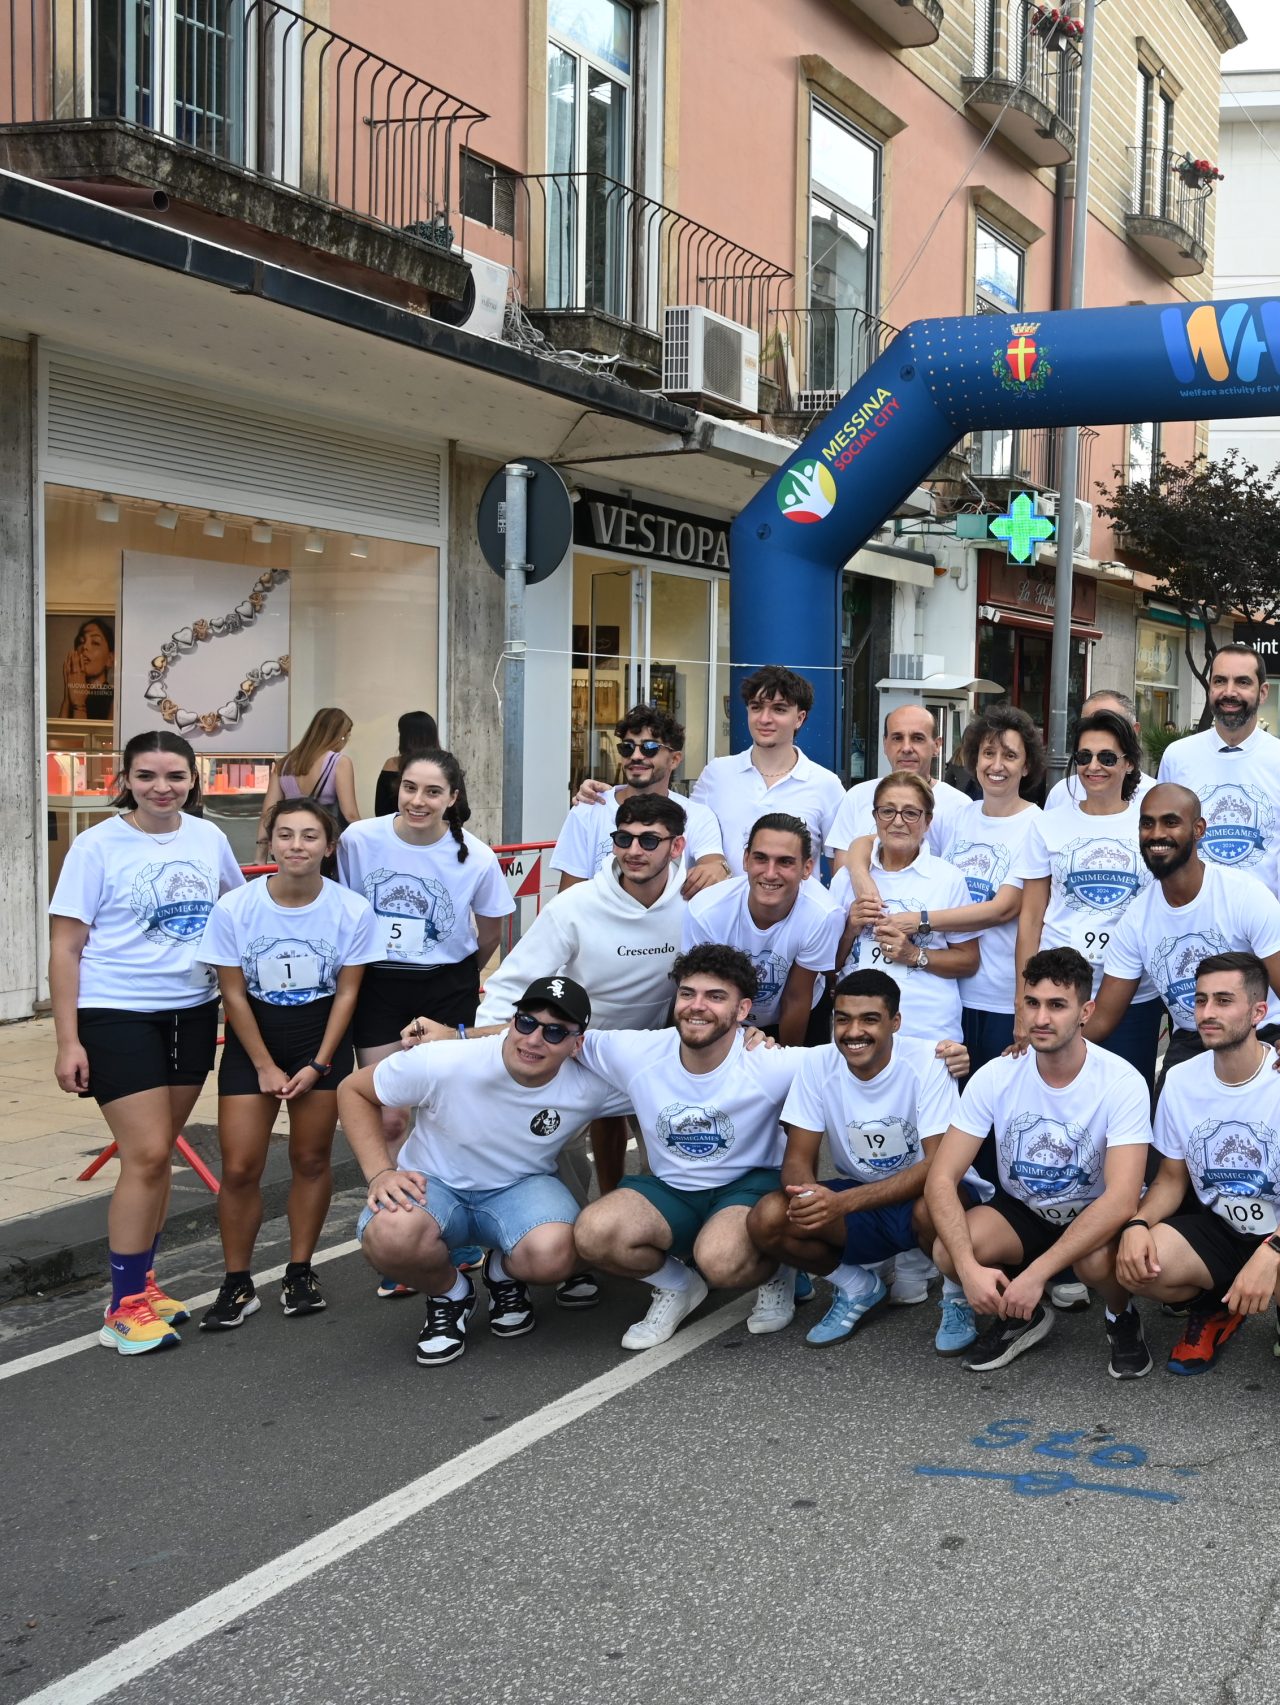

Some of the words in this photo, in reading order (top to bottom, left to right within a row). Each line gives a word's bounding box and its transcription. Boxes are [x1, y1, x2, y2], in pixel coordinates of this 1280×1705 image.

[1180, 388, 1217, 397] Welfare
[1219, 385, 1255, 396] activity
[822, 387, 892, 462] MESSINA
[833, 428, 878, 472] SOCIAL
[874, 397, 901, 428] CITY
[593, 502, 730, 568] VESTOPA
[1070, 873, 1136, 886] UNIMEGAMES
[390, 923, 402, 940] 5
[1084, 931, 1110, 950] 99
[617, 942, 675, 957] Crescendo
[284, 963, 292, 979] 1
[863, 1134, 885, 1149] 19
[1224, 1203, 1264, 1222] 108
